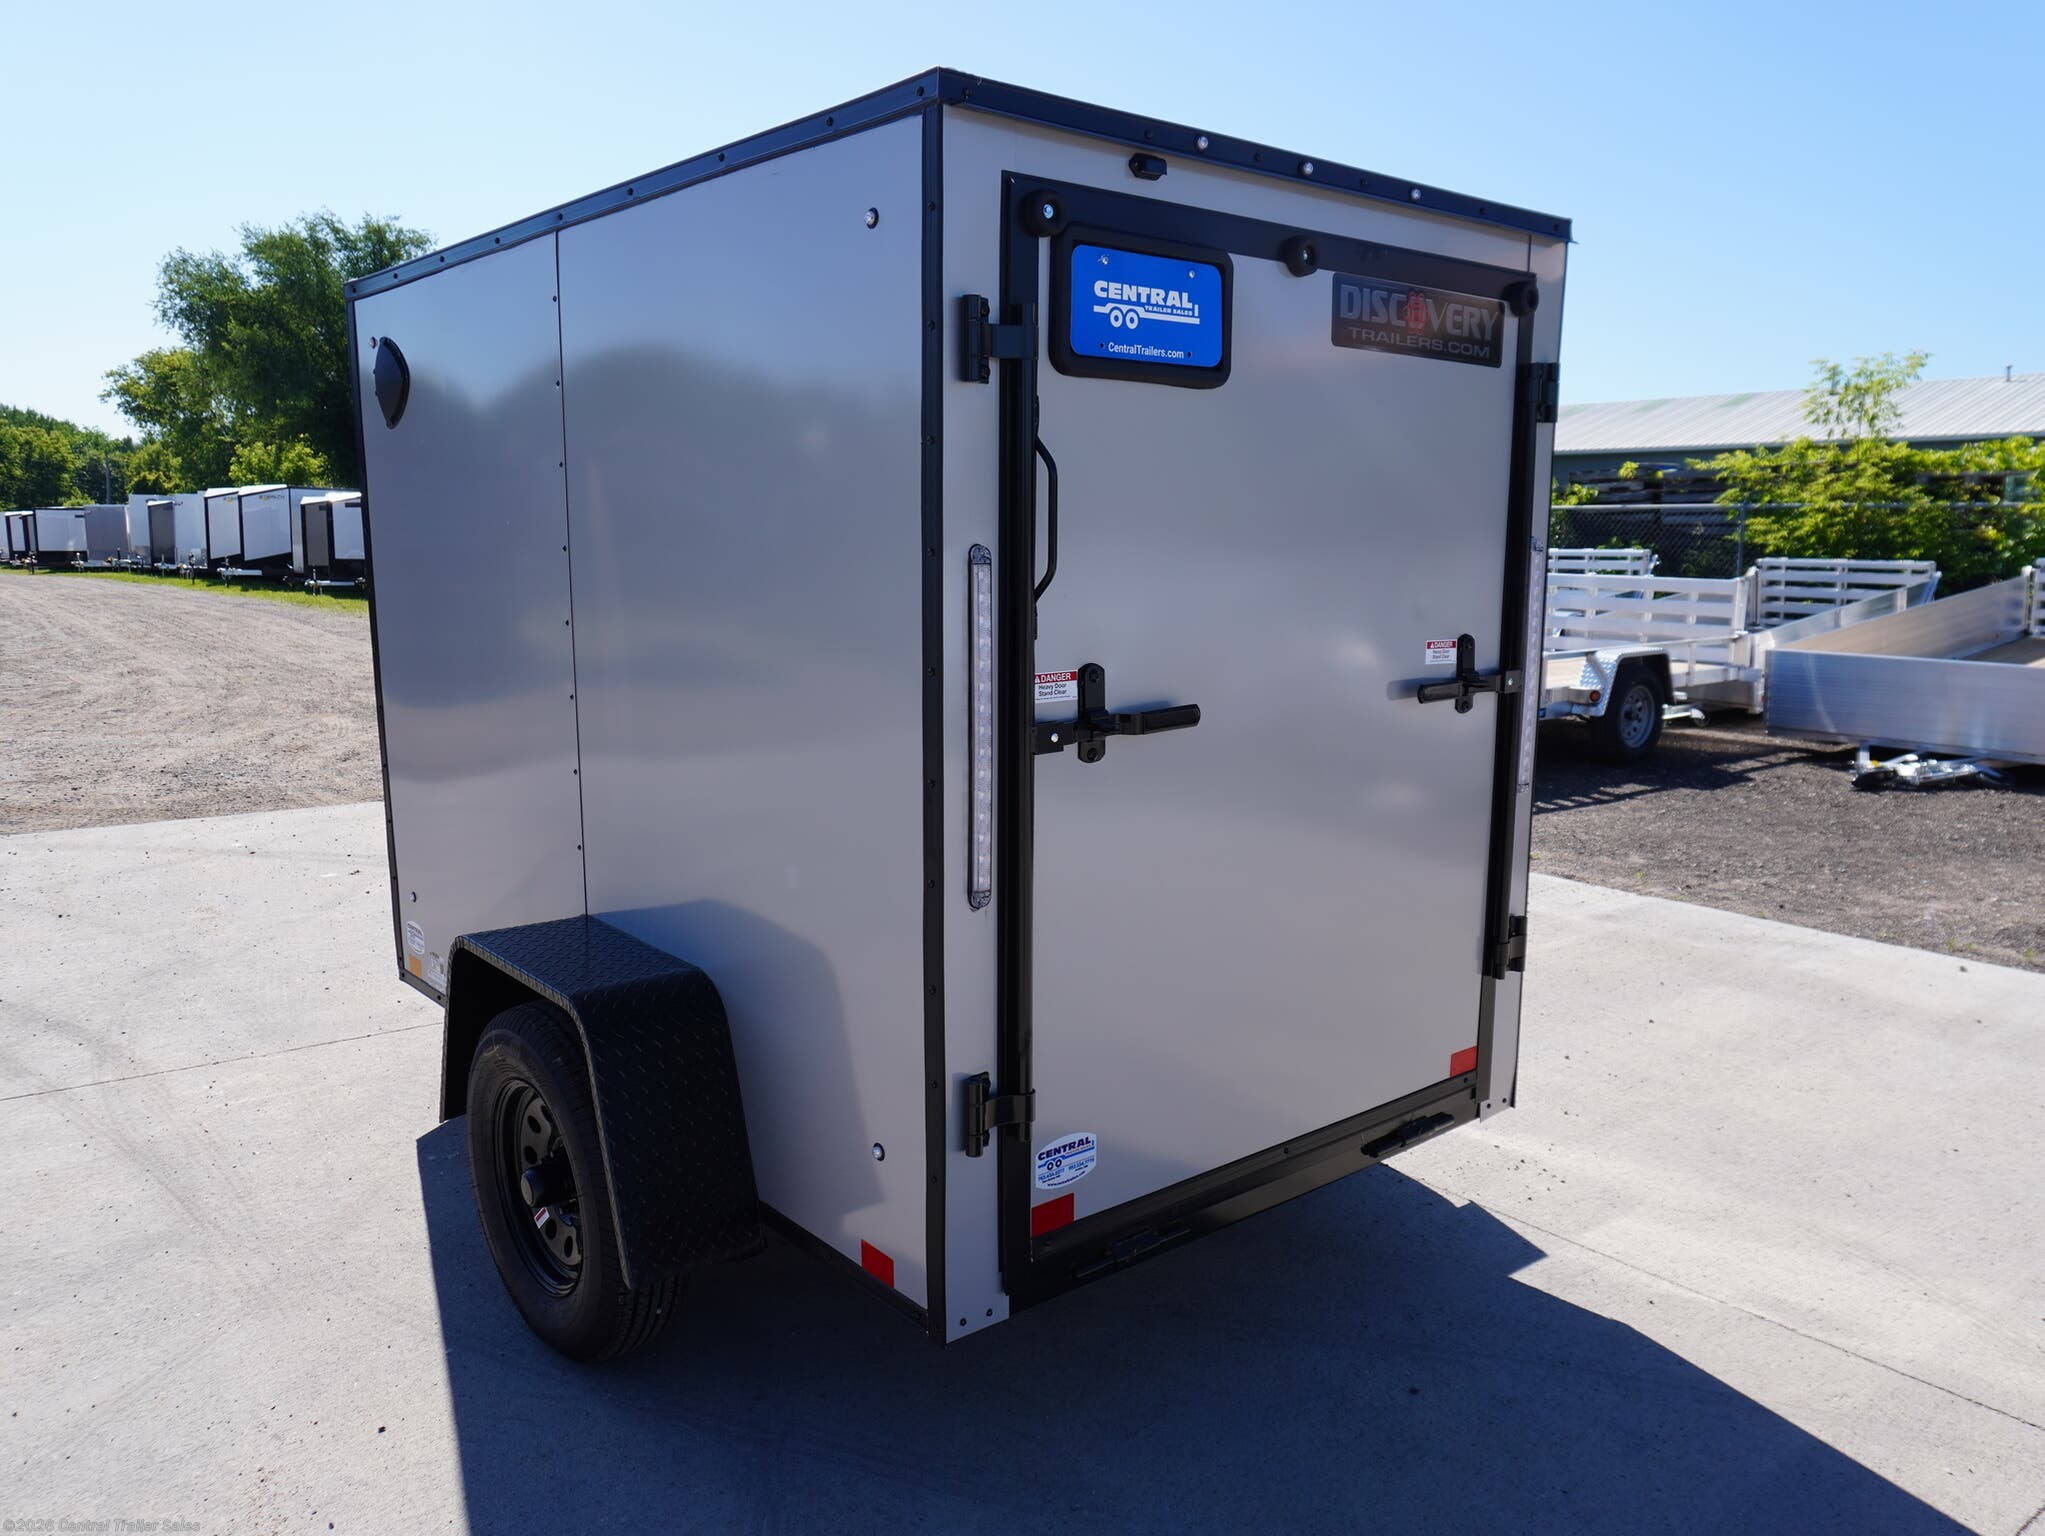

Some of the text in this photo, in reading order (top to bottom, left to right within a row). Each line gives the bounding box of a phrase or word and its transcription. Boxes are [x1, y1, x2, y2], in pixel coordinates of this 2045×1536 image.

[1093, 280, 1193, 308] CENTRAL
[1144, 305, 1193, 316] TRAILER SALES
[1108, 342, 1185, 359] CentralTrailers.com
[1348, 327, 1490, 358] TRAILERS.COM
[1040, 672, 1072, 683] DANGER
[1037, 1136, 1092, 1161] CENTRAL
